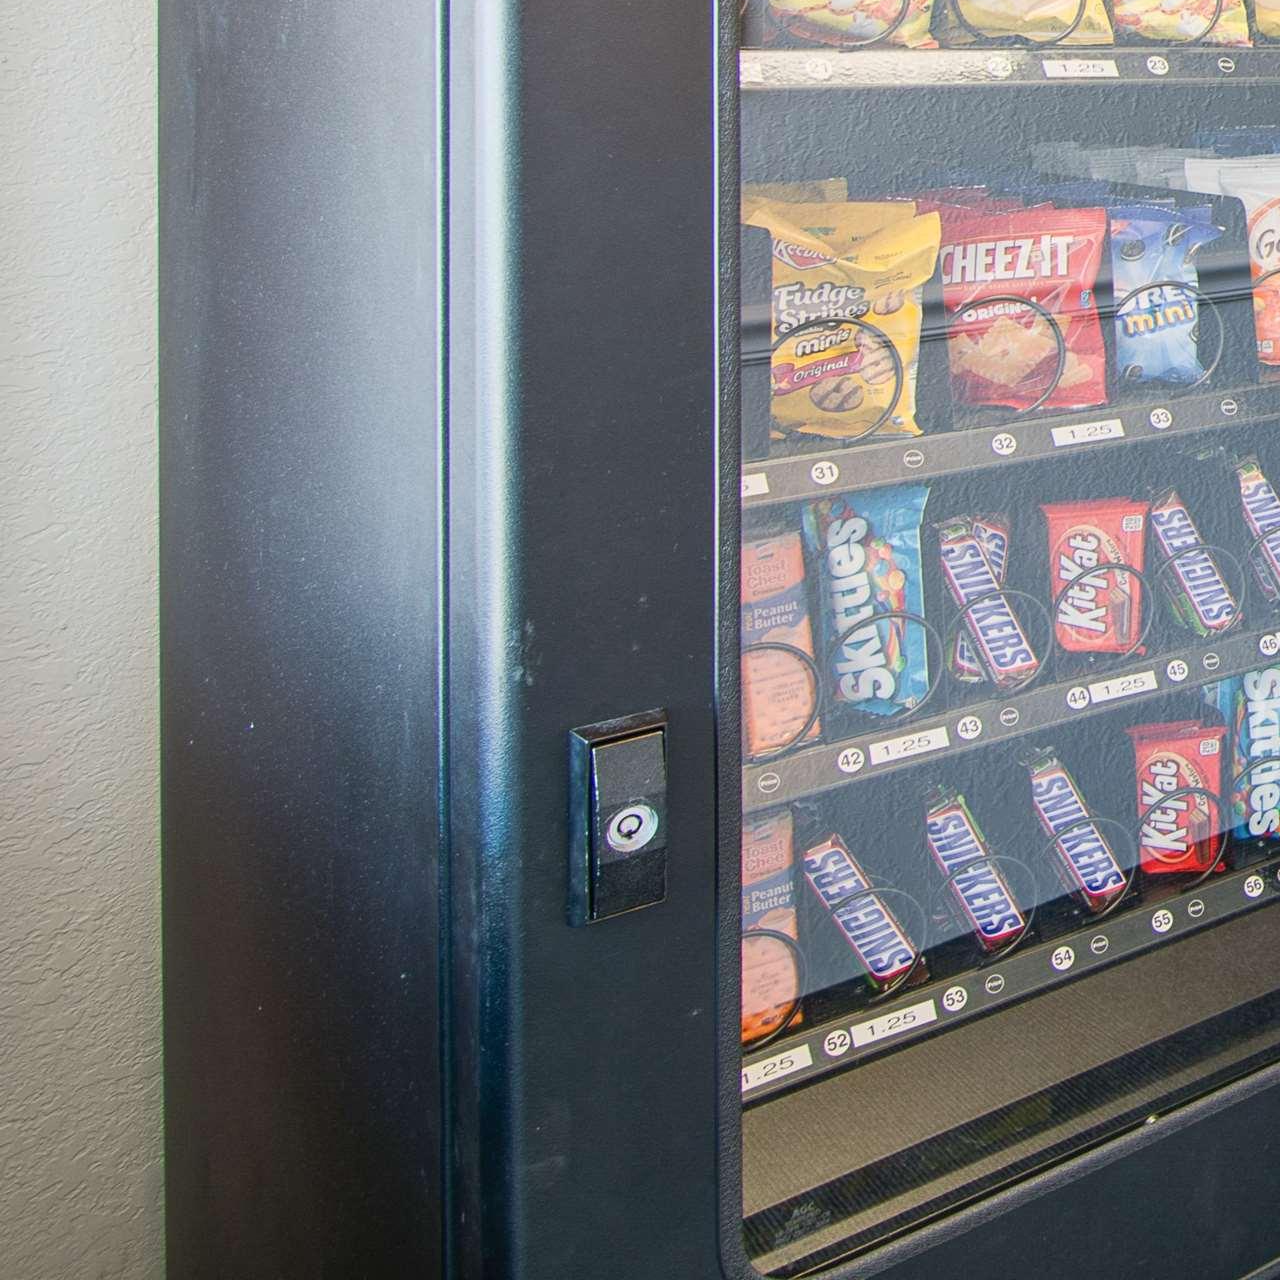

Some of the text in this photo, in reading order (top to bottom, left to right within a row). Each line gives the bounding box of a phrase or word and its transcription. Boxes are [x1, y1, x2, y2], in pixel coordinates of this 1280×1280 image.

[1150, 59, 1166, 71] 23
[774, 283, 862, 310] Fudge
[1126, 300, 1194, 335] mini
[794, 357, 849, 382] Original
[1154, 411, 1169, 425] 33
[1069, 424, 1112, 439] 1.25
[994, 438, 1014, 451] 32
[816, 466, 835, 480] 31
[1153, 507, 1234, 623] SNICKERS
[753, 601, 798, 619] Peanut
[828, 516, 896, 701] Skittles
[942, 543, 1033, 668] SNICKERS
[754, 614, 795, 630] Butter
[1261, 638, 1278, 652] 46
[1169, 663, 1187, 677] 45
[1102, 677, 1146, 695] 1.25
[1069, 692, 1087, 705] 44
[960, 721, 980, 735] 43
[883, 735, 931, 756] 1.25
[841, 751, 861, 767] 42
[1033, 775, 1125, 893] SNICKERS
[928, 811, 1024, 938] SNICKERS
[751, 881, 795, 902] Peanut
[1246, 879, 1262, 893] 56
[752, 893, 792, 913] Butter
[805, 849, 915, 976] SNICKERS
[1153, 913, 1171, 928] 55
[1054, 950, 1074, 965] 54
[945, 990, 965, 1006] 53
[867, 1011, 917, 1036] 1.25
[827, 1034, 849, 1052] 52
[742, 1055, 795, 1084] 1.25
